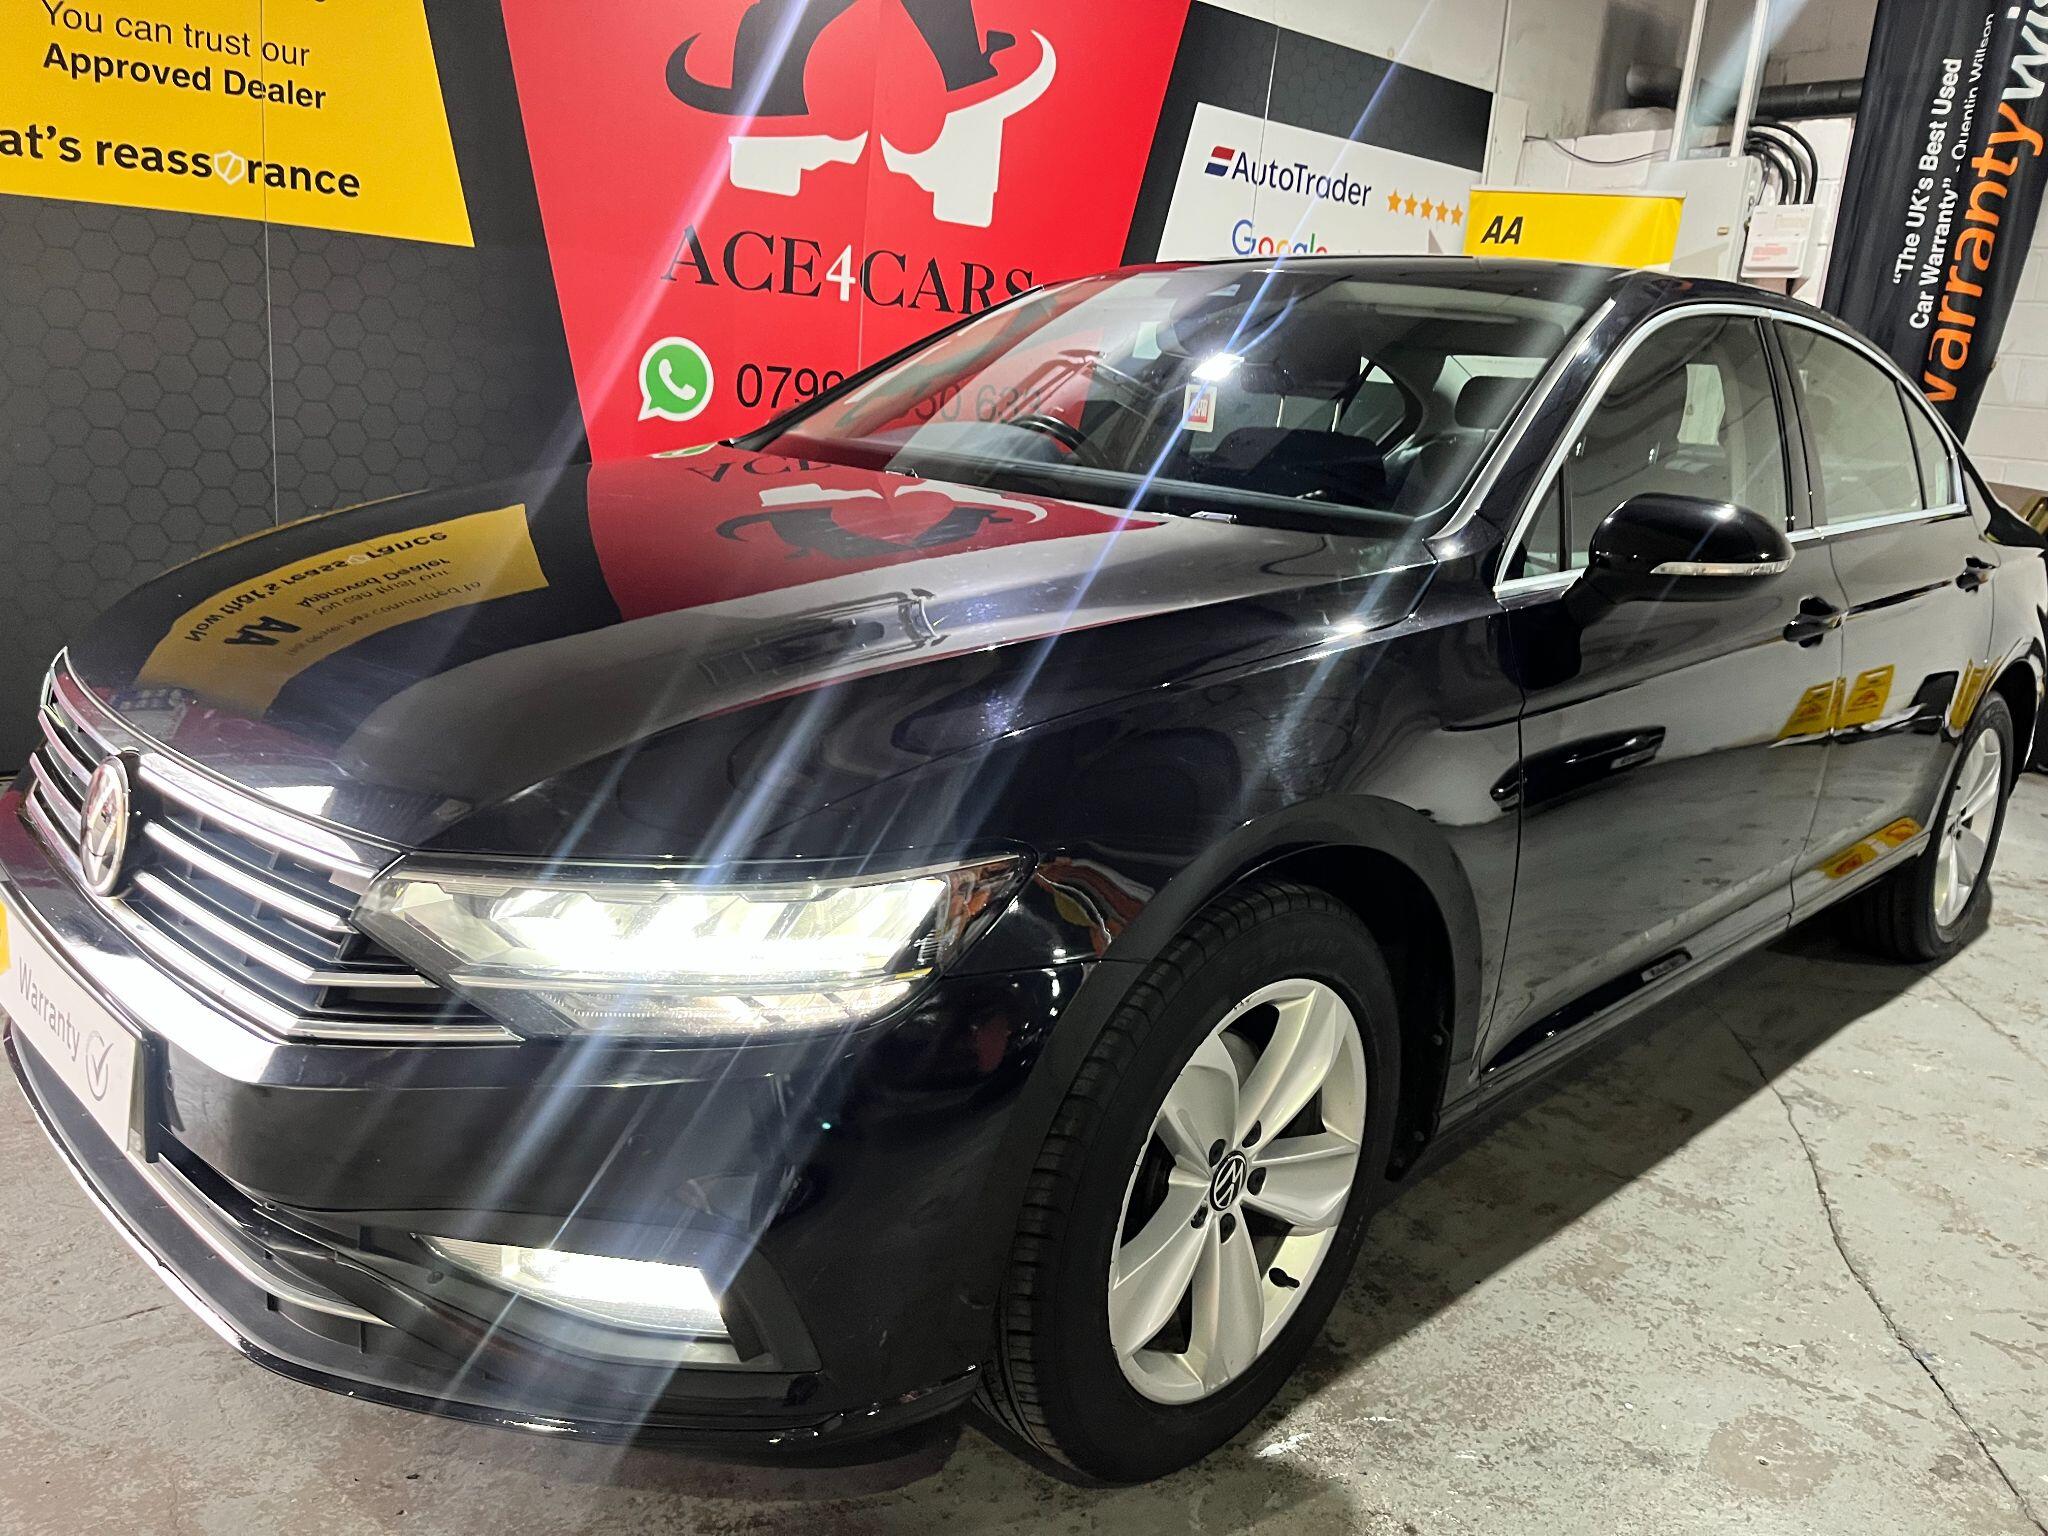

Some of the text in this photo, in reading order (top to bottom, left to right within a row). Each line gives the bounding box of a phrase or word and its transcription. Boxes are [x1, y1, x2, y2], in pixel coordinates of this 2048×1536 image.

[42, 0, 310, 66] You can trust our
[43, 42, 327, 109] Approved Dealer
[1930, 58, 1963, 115] Used
[1909, 291, 1935, 329] Car
[1951, 86, 1979, 160] Quentin
[1968, 13, 1995, 83] Willson
[1918, 120, 1948, 171] Best
[1231, 151, 1373, 208] AutoTrader
[1905, 177, 1935, 228] UK's
[1481, 215, 1524, 245] AA
[660, 223, 1034, 317] ACE4CARS
[19, 956, 81, 1063] Warranty
